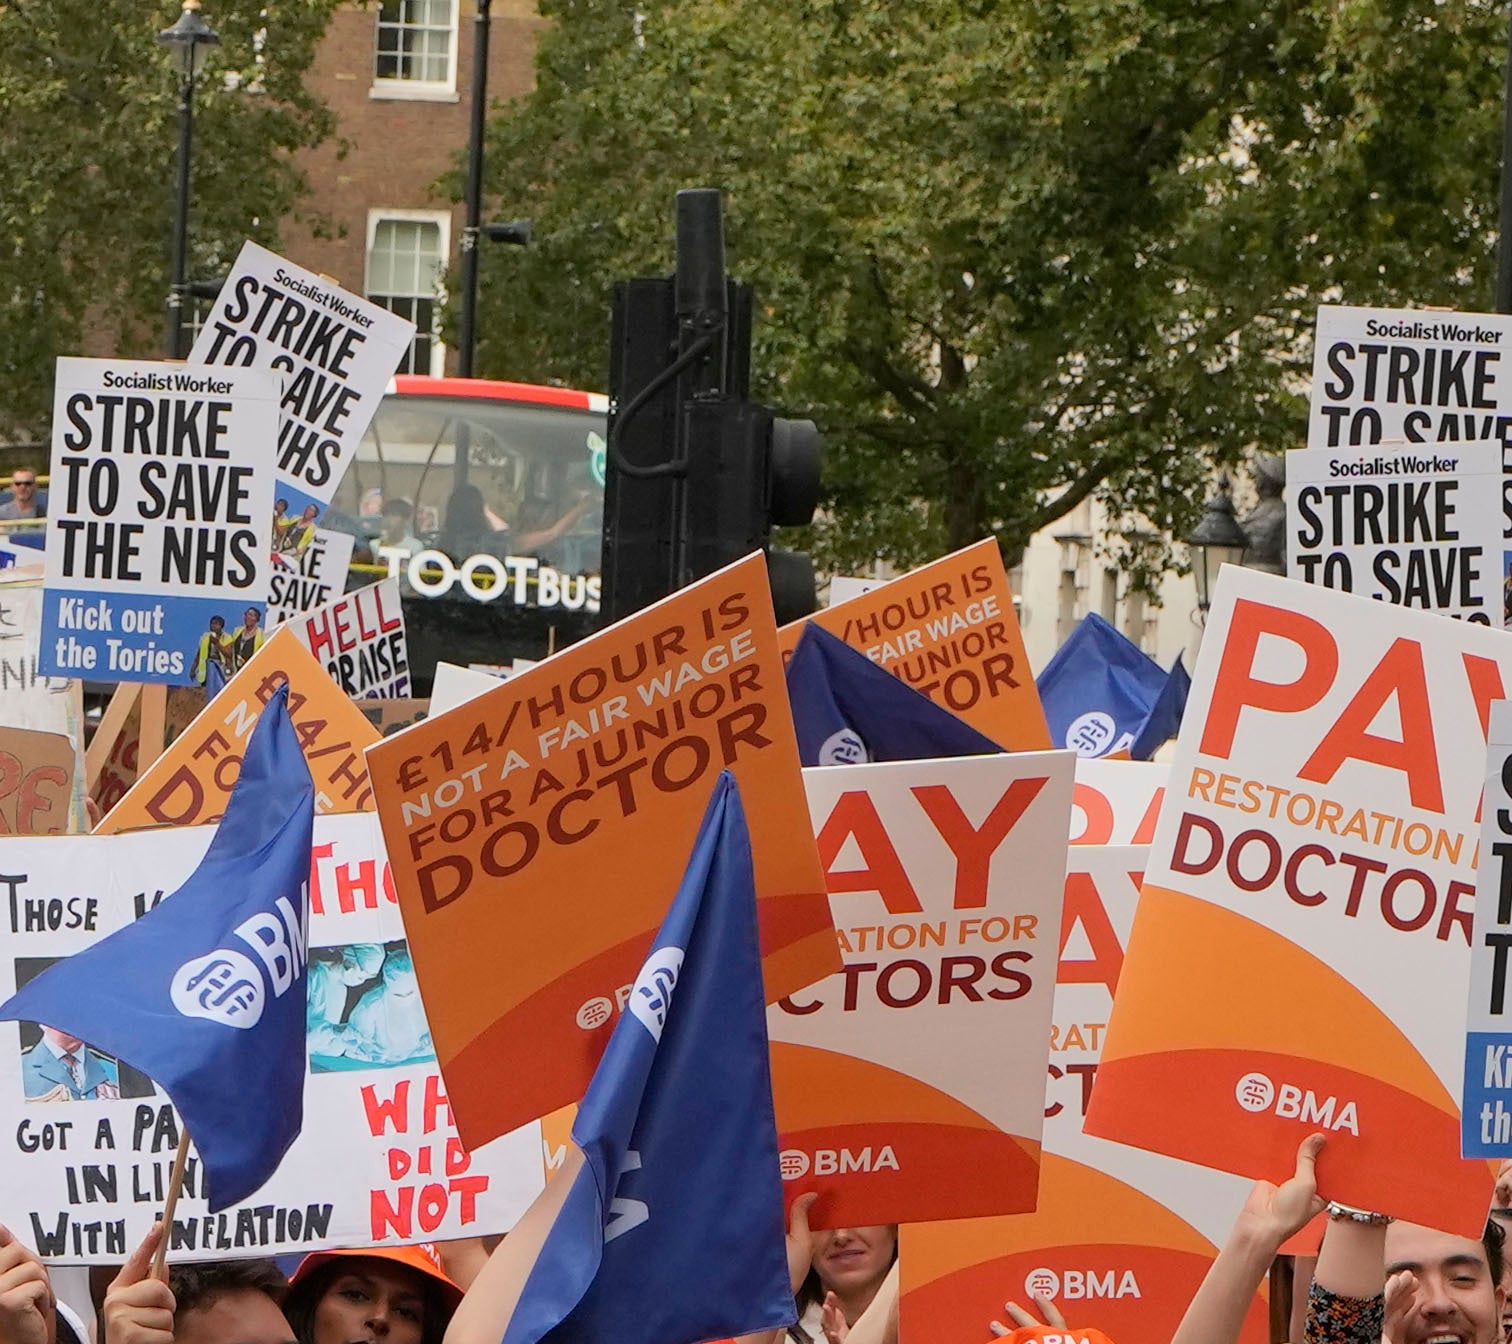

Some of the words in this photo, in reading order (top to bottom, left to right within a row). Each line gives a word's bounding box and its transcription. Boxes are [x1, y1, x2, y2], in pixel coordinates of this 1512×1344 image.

[224, 275, 367, 380] STRIKE
[1325, 342, 1501, 409] STRIKE
[64, 393, 232, 459] STRIKE
[1322, 406, 1382, 447] TO
[61, 457, 119, 516] TO
[137, 461, 254, 524] SAVE
[1297, 480, 1459, 549] STRIKE
[57, 520, 144, 581] THE
[161, 526, 257, 589] NHS
[960, 565, 993, 598] IS
[1297, 552, 1352, 593] TO
[1373, 546, 1483, 609] SAVE
[58, 597, 113, 631] Kick
[121, 605, 165, 635] out
[306, 584, 402, 659] HELL
[926, 595, 1001, 642] WAGE
[55, 637, 98, 670] the
[106, 639, 184, 675] Tories
[396, 624, 688, 793] £14/HOUR
[701, 592, 750, 641] IS
[401, 764, 489, 827] NOT
[499, 749, 529, 781] A
[538, 695, 631, 759] FAIR
[638, 629, 758, 707] WAGE
[407, 788, 516, 862] FOR
[528, 769, 565, 806] A
[573, 663, 765, 788] JUNIOR
[416, 703, 773, 915] DOCTOR
[1188, 768, 1464, 865] RESTORATION
[958, 915, 1039, 946] FOR
[16, 1119, 72, 1153] GOT
[95, 1118, 116, 1150] A
[1275, 1083, 1360, 1137] BMA
[66, 1165, 117, 1205] IN
[384, 1138, 471, 1180] DID
[814, 1145, 901, 1177] BMA
[31, 1212, 126, 1258] WITH
[370, 1176, 489, 1241] NOT
[1063, 1270, 1141, 1299] BMA
